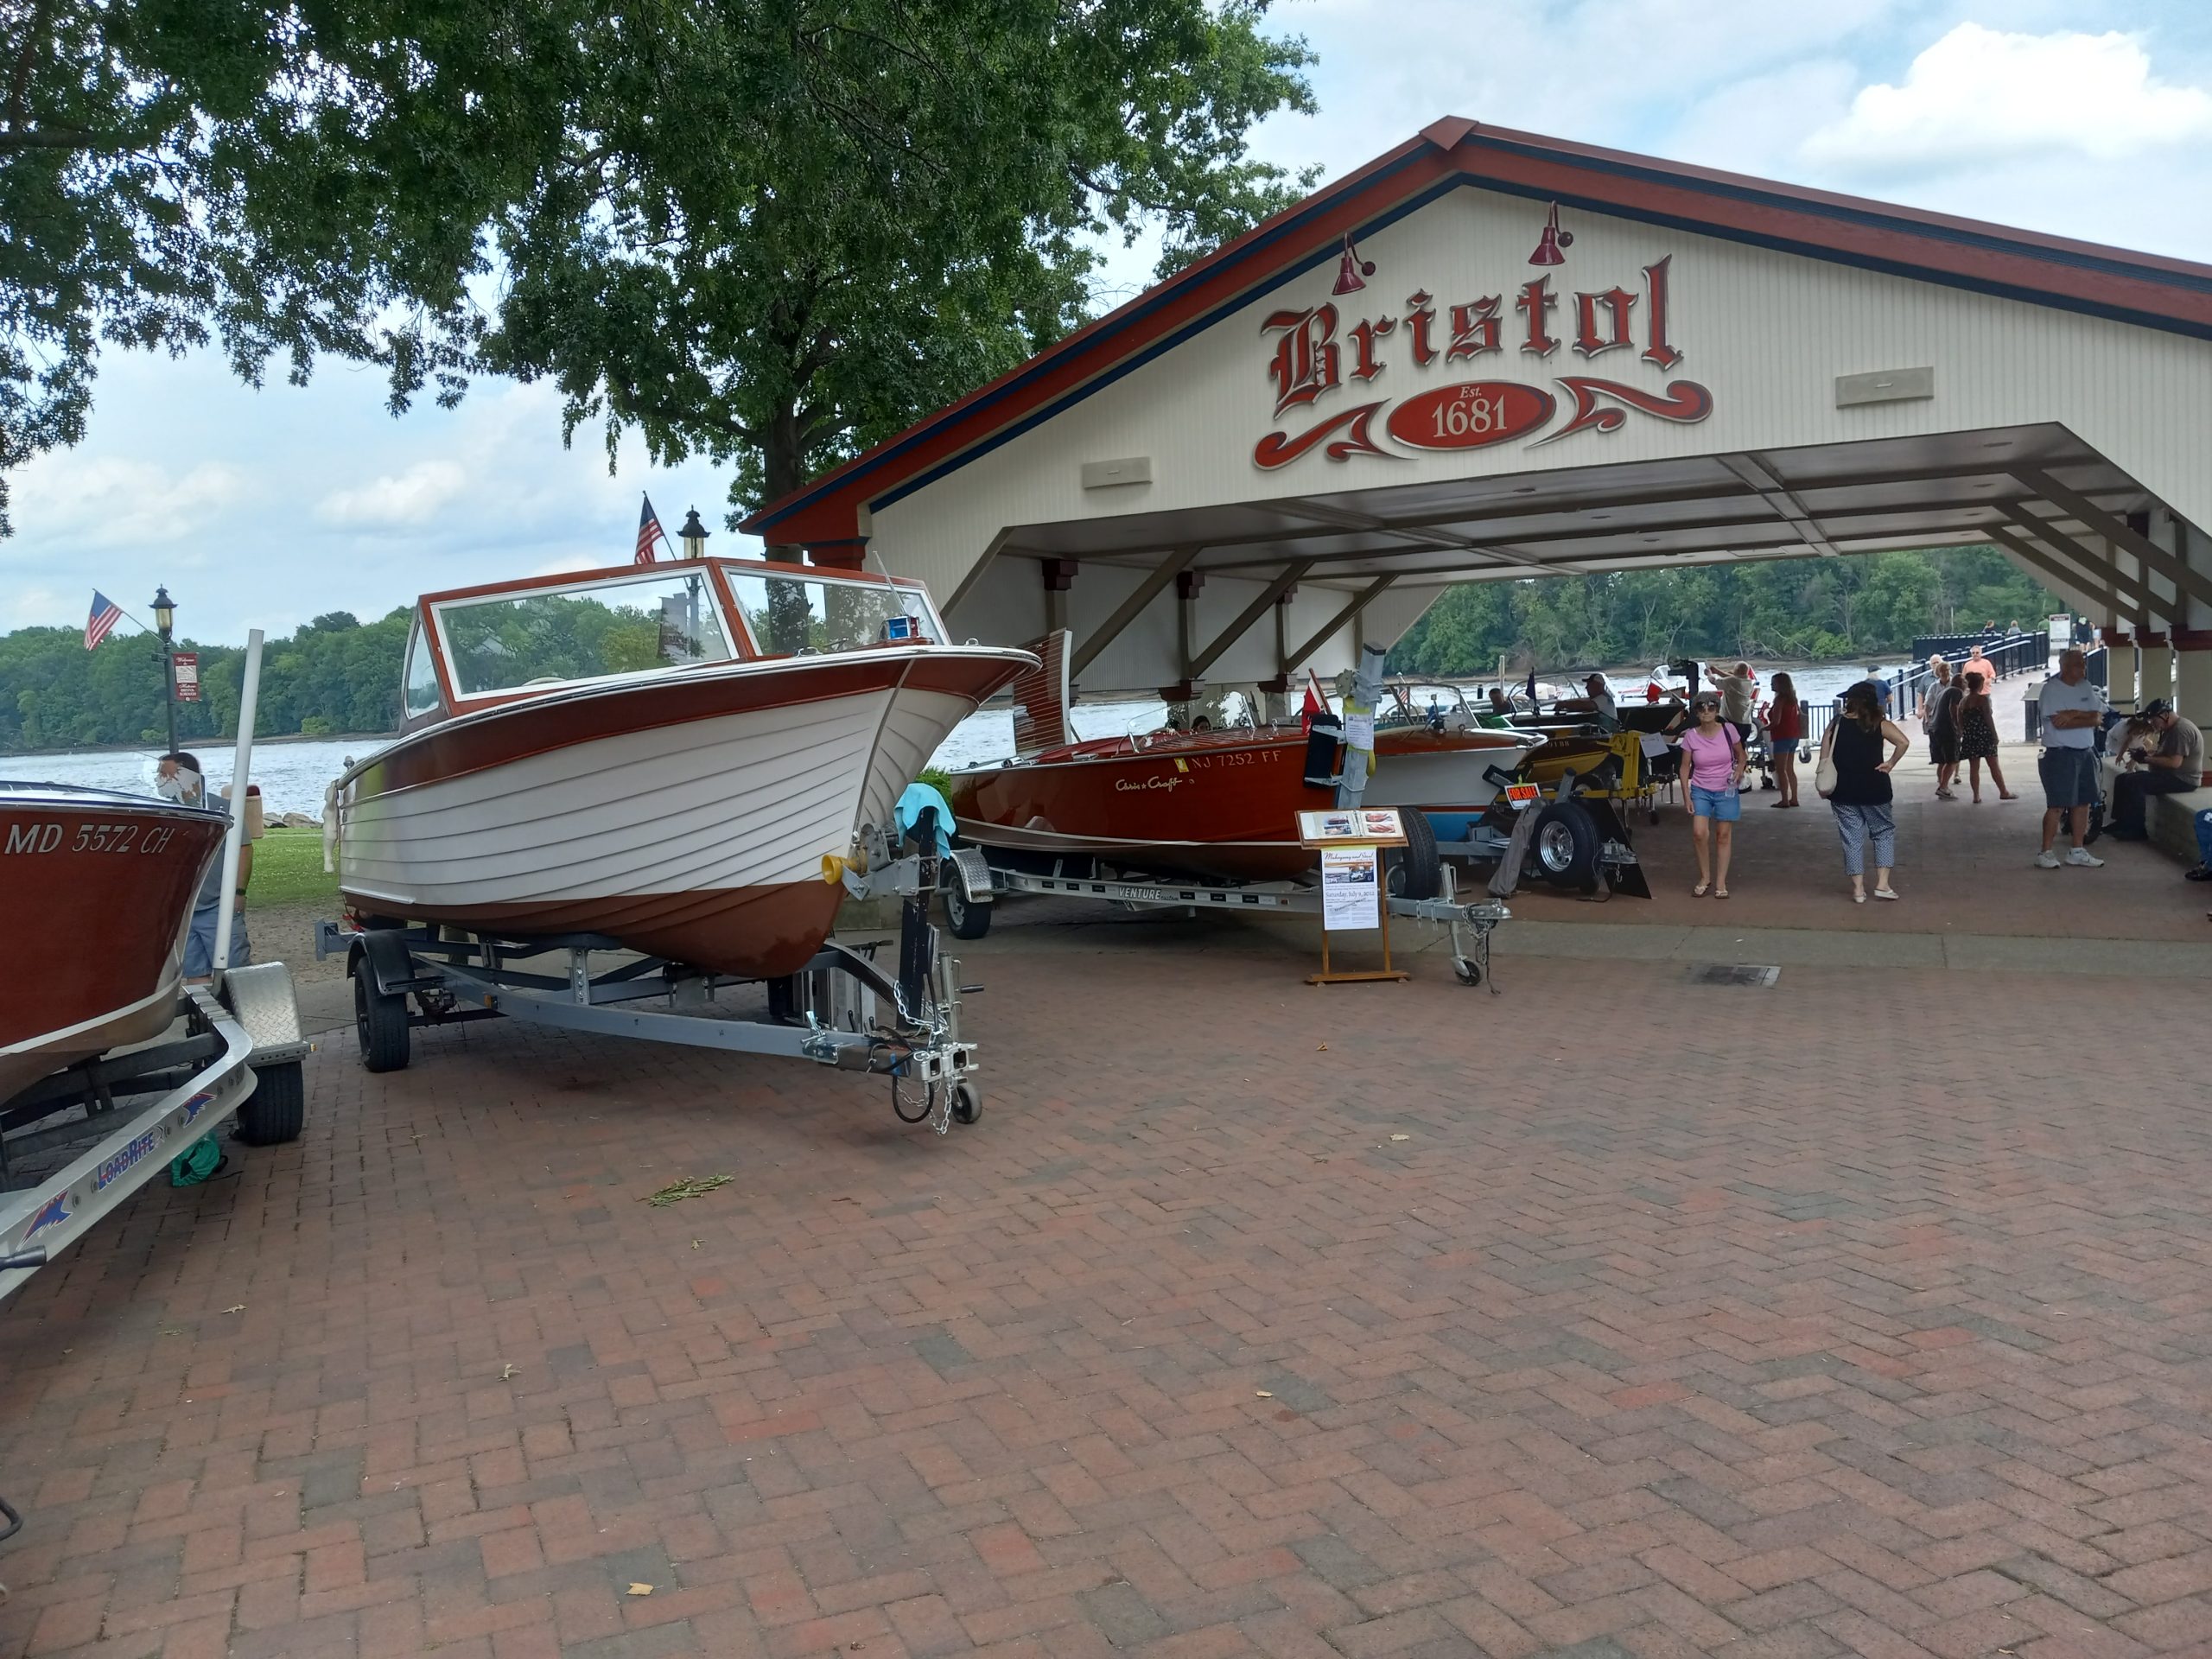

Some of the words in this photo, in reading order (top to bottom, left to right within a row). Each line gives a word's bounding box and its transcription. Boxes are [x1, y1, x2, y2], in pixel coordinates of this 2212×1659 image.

[1261, 253, 1683, 419] Bristol
[1459, 386, 1482, 398] Est.
[1432, 394, 1507, 437] 1681
[1192, 757, 1211, 769] NJ
[1217, 753, 1255, 766] 7252
[1262, 750, 1281, 762] FF
[1508, 787, 1522, 800] FOR
[1521, 785, 1538, 799] SALE
[4, 824, 63, 854] MD
[72, 824, 138, 852] 5572
[140, 827, 175, 853] CH
[1119, 887, 1161, 901] VENTURE
